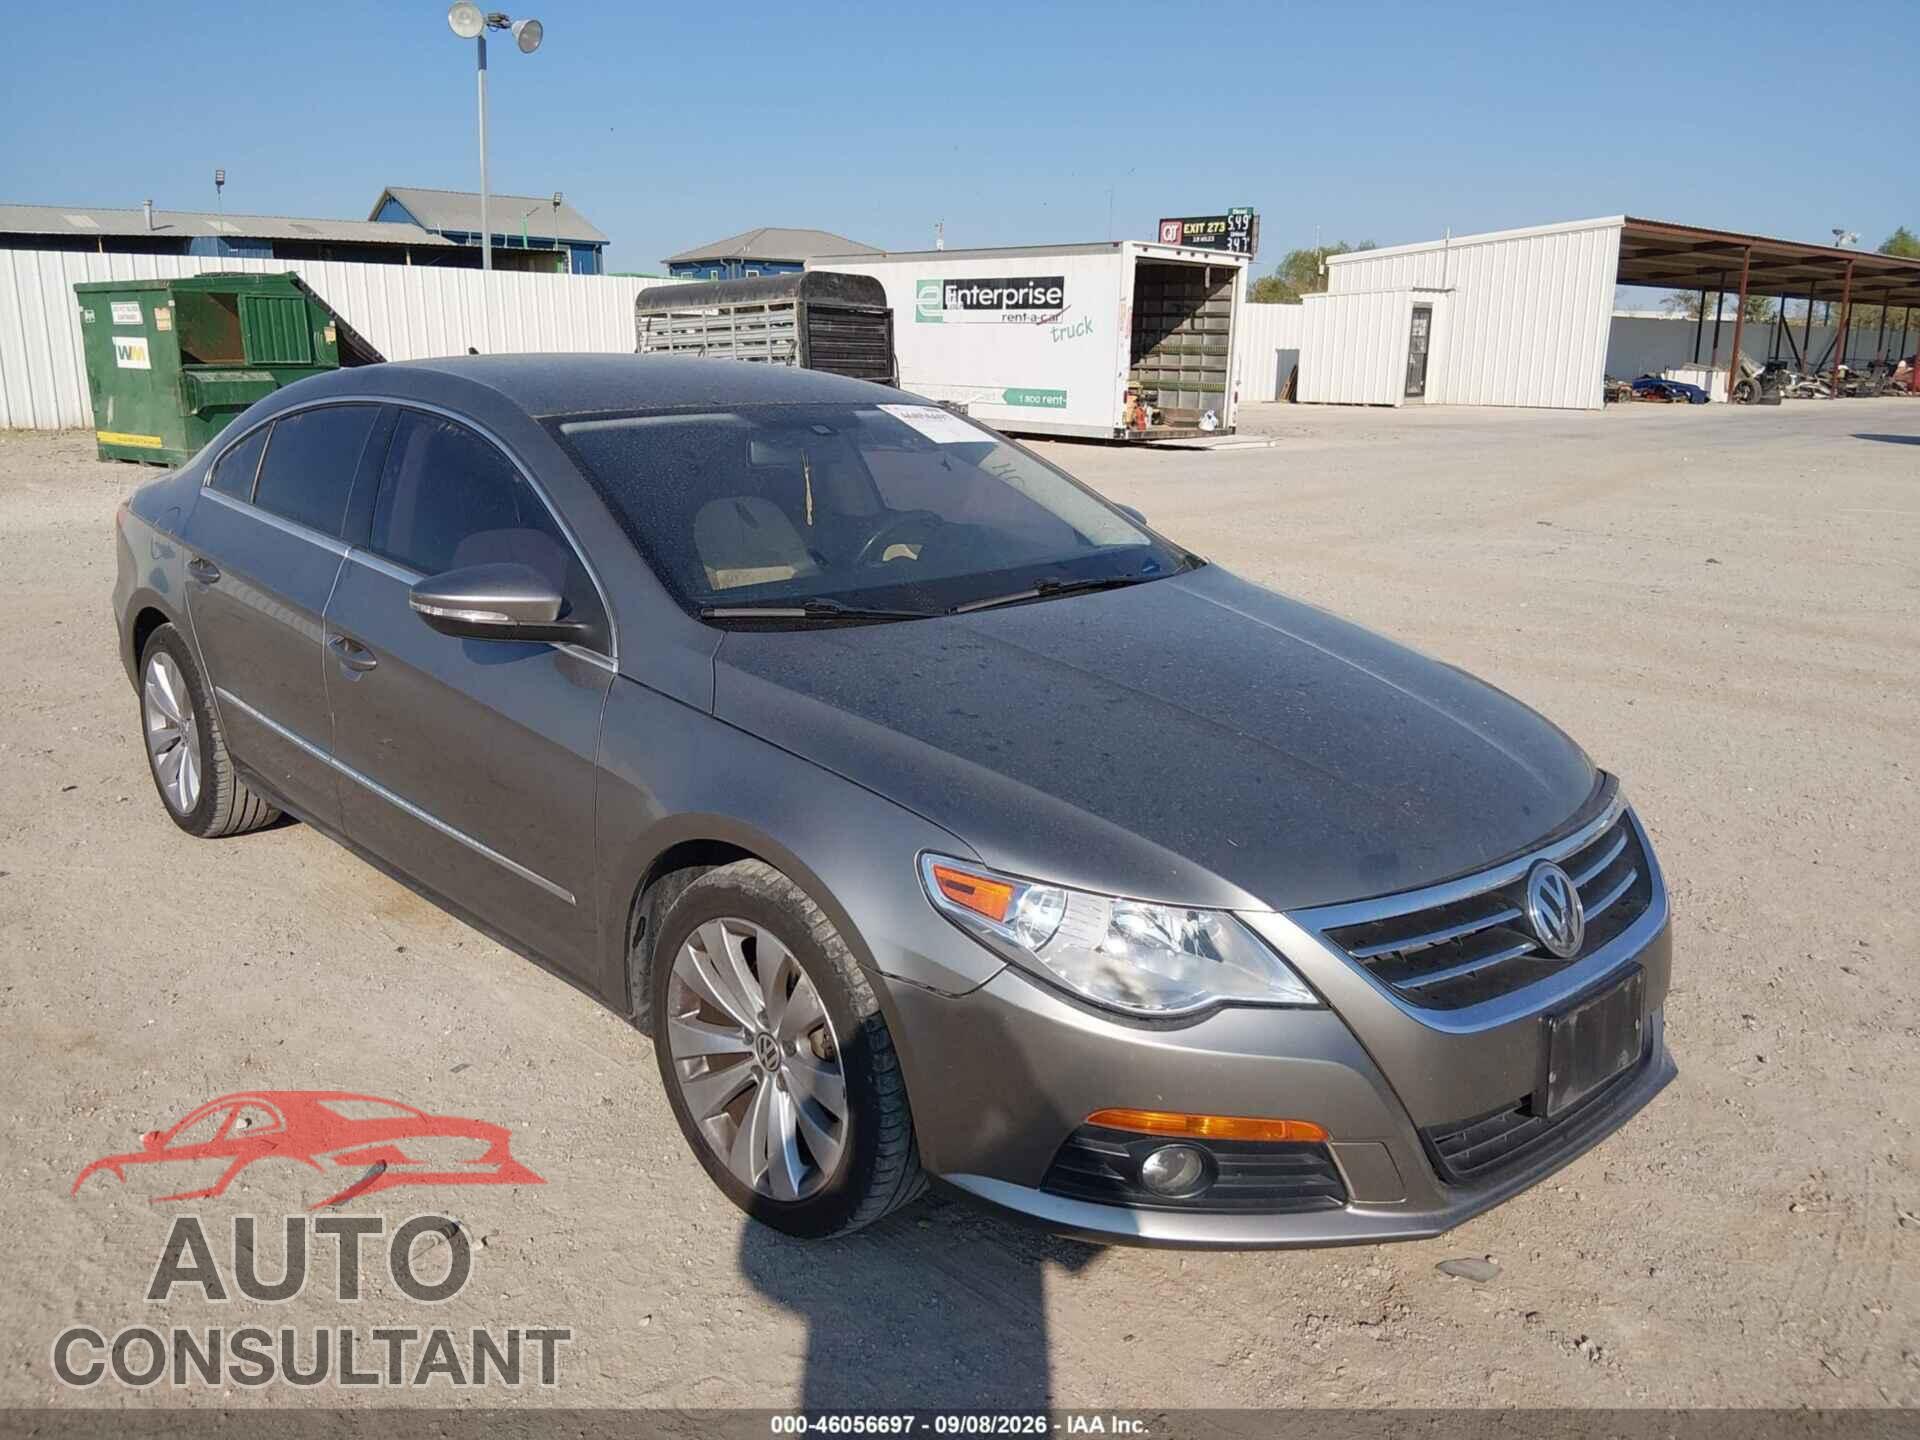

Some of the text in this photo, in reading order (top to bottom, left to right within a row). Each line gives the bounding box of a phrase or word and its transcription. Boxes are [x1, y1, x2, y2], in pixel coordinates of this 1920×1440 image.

[1162, 225, 1178, 241] QT
[1184, 222, 1226, 234] EXIT 273
[945, 281, 1062, 310] Enterprise
[1050, 315, 1093, 343] truck
[118, 344, 145, 361] WM
